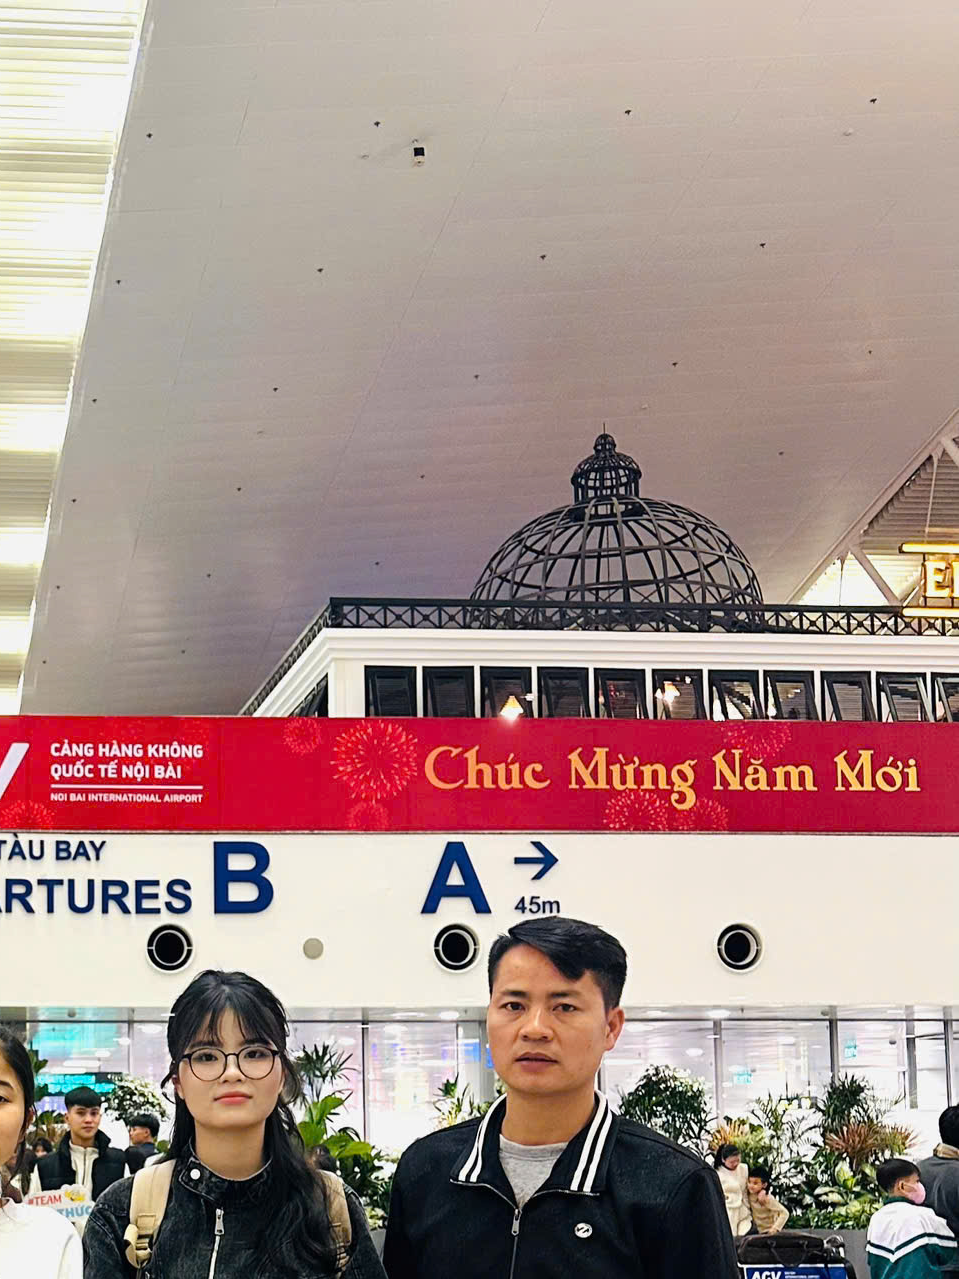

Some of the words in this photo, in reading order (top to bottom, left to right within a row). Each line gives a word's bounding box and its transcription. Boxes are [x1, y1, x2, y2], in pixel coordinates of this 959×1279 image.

[50, 739, 94, 758] CẢNG
[98, 740, 144, 758] HÀNG
[147, 741, 204, 758] KHÔNG
[50, 759, 94, 780] QUỐC
[98, 759, 118, 779] TẾ
[121, 761, 150, 782] NỘI
[154, 762, 182, 779] BÀI
[424, 745, 551, 790] Chúc
[568, 747, 698, 811] Mừng
[712, 749, 818, 791] Năm
[834, 749, 921, 792] Mới
[50, 793, 68, 801] NOI
[69, 793, 86, 802] BAI
[88, 793, 162, 803] INTERNATIONAL
[163, 794, 204, 803] AIRPORT
[55, 840, 107, 861] BAY
[213, 841, 274, 915] B
[420, 841, 492, 914] A
[514, 896, 561, 914] 45m
